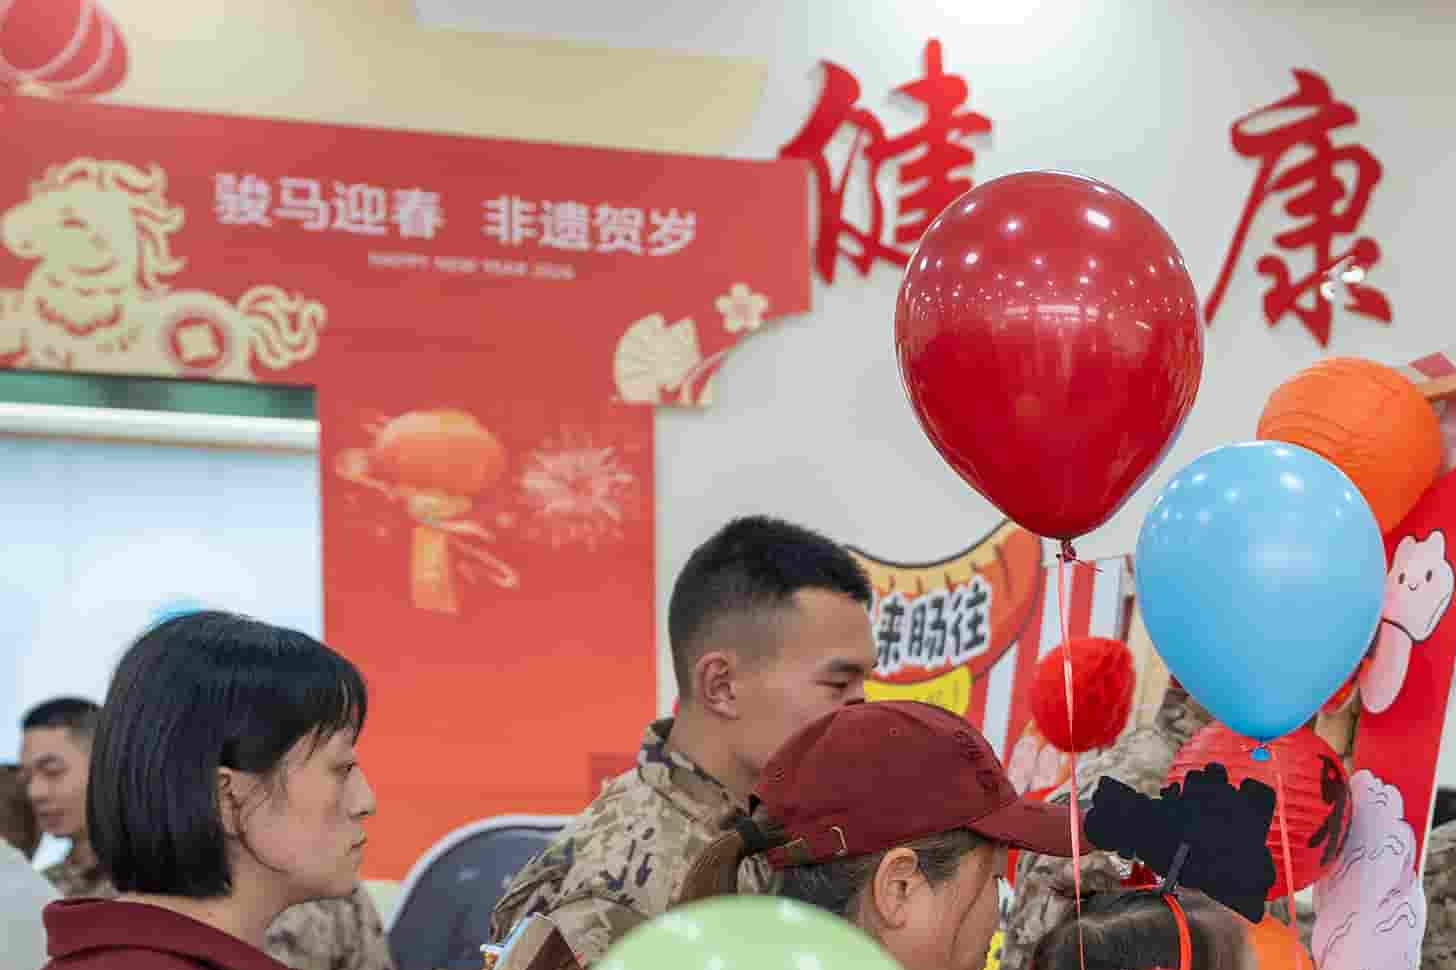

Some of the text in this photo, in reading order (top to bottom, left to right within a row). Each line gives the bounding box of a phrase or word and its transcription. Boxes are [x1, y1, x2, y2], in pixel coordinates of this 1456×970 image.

[213, 172, 697, 257] 骏马迎春 非遗贺岁
[868, 582, 988, 668] 来肠往
